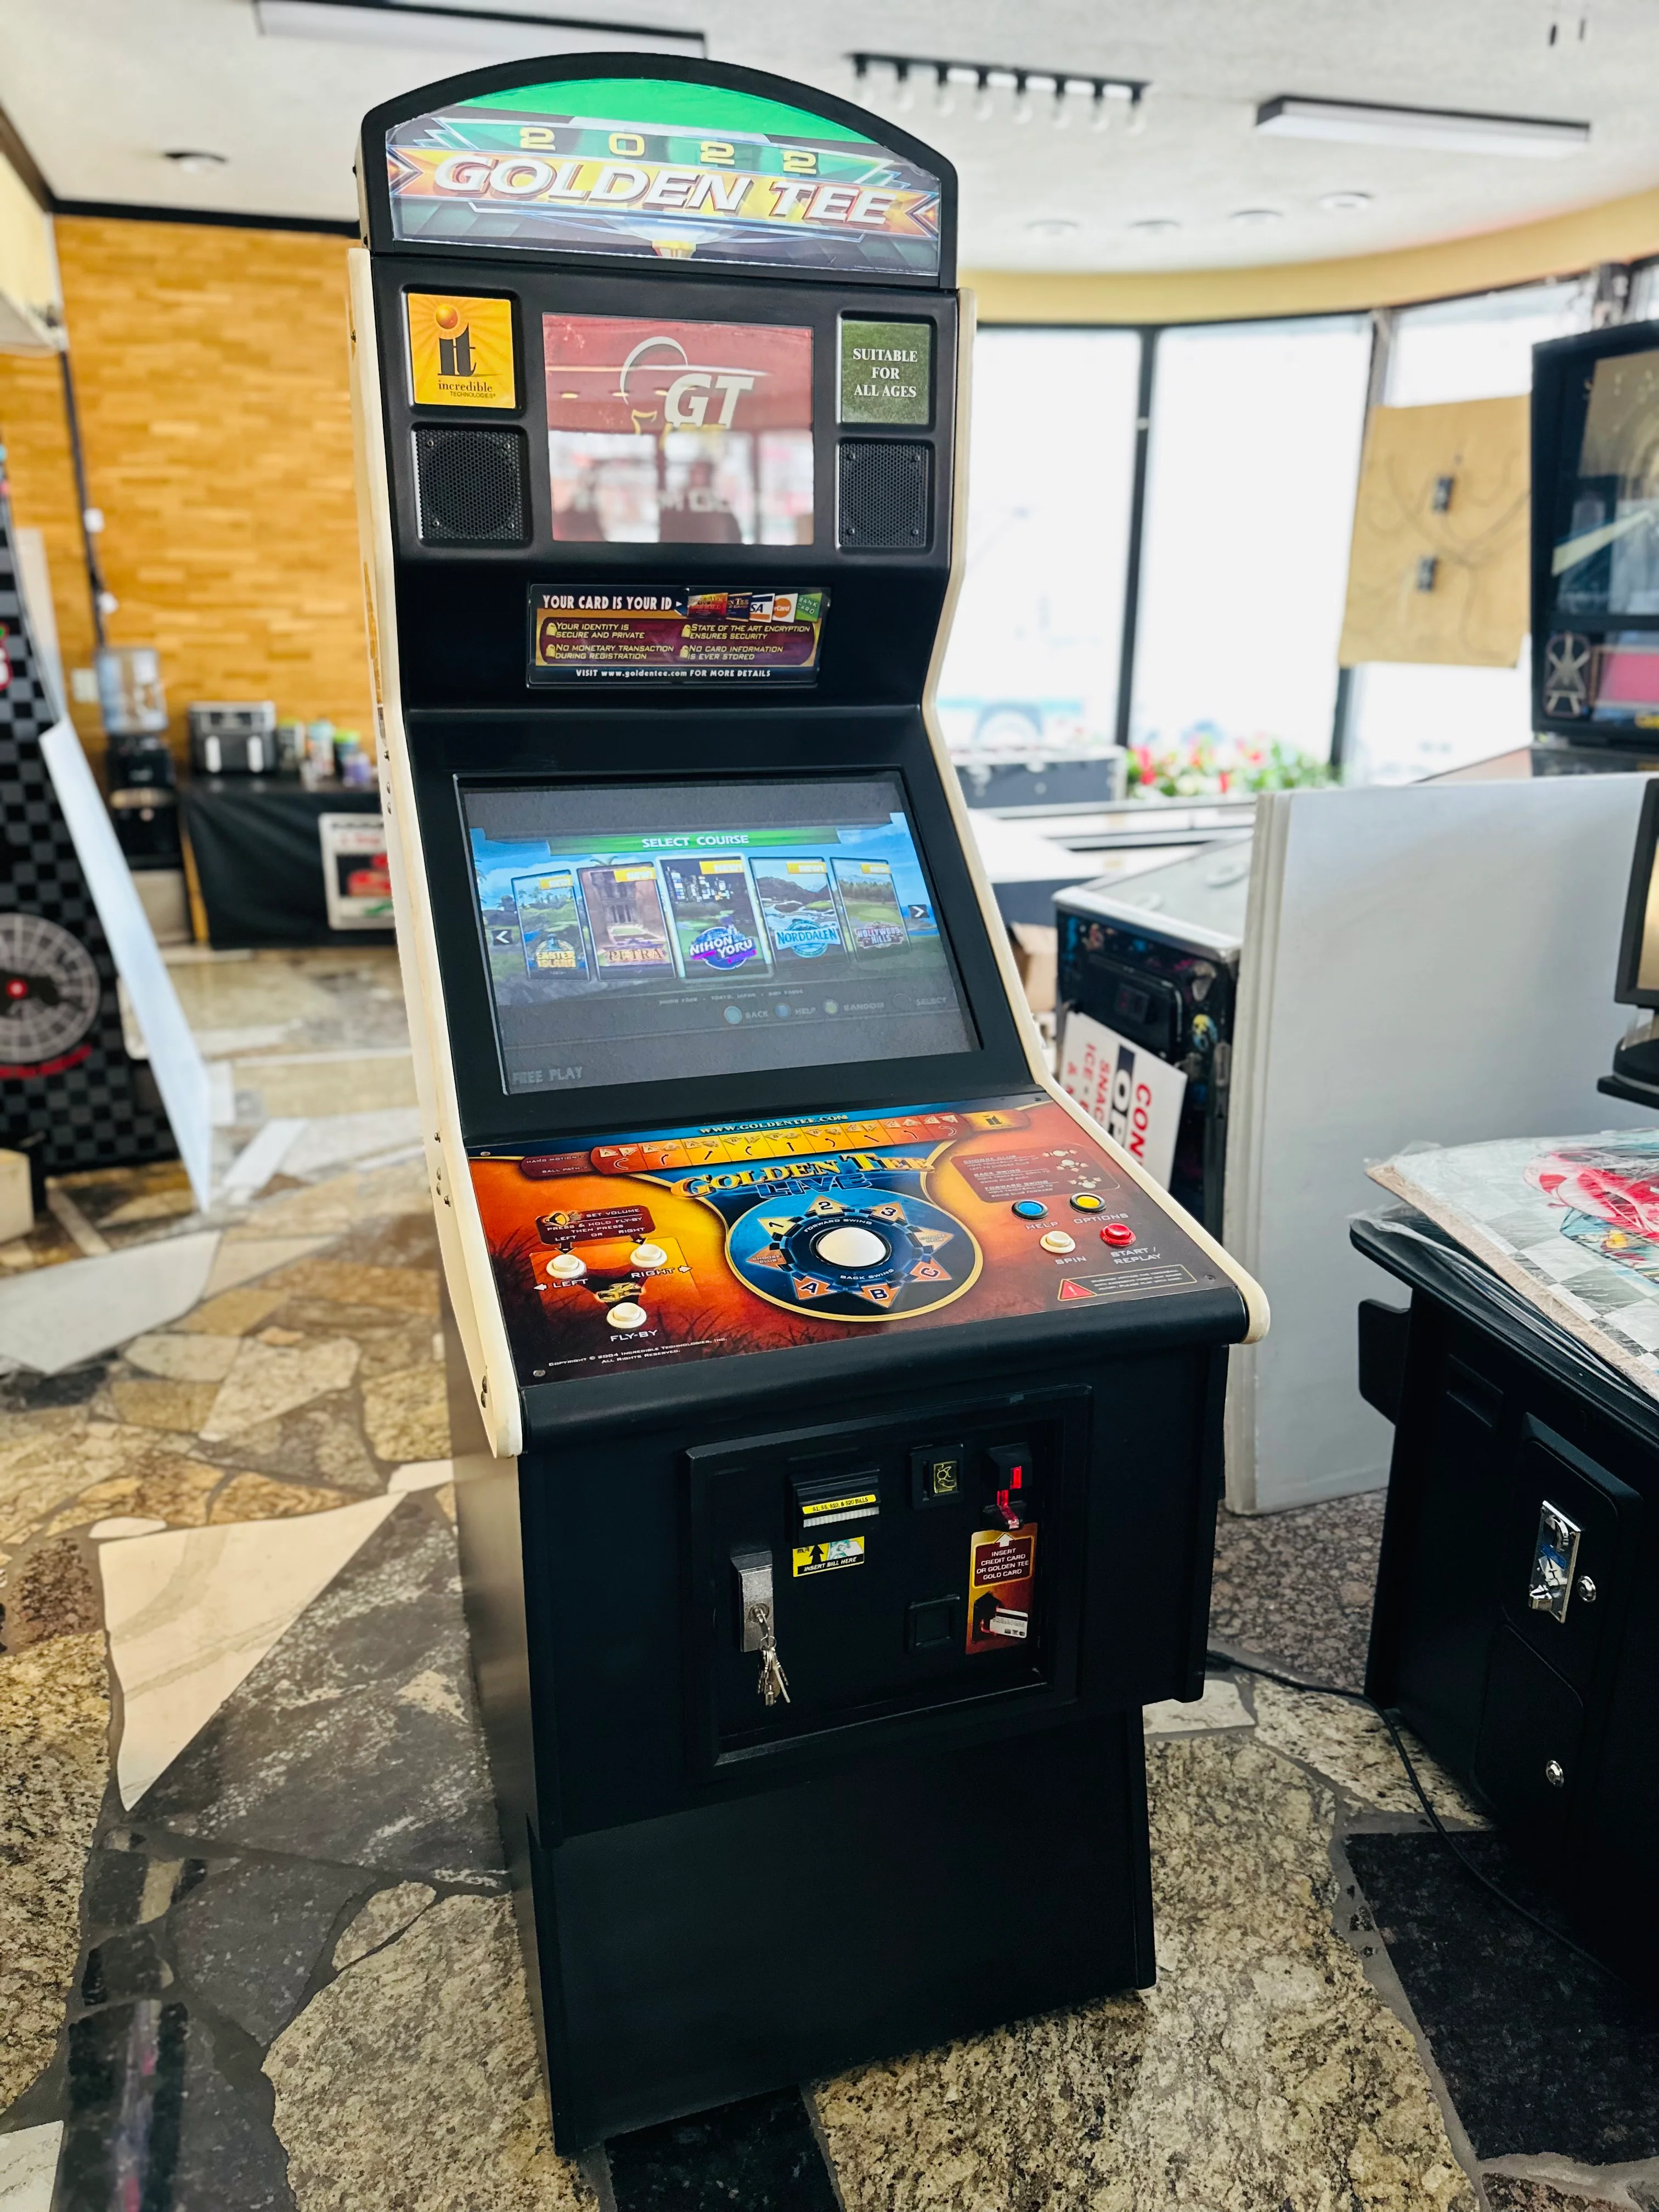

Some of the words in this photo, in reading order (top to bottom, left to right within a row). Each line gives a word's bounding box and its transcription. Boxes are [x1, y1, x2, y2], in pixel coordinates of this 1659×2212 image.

[434, 155, 753, 213] GOLDEN
[768, 181, 898, 225] TEE
[853, 348, 917, 362] SUITABLE
[871, 367, 900, 379] FOR
[438, 380, 492, 392] incredible
[854, 385, 879, 396] ALL
[882, 385, 917, 397] AGES
[664, 373, 754, 428] GT
[543, 595, 574, 609] YOUR
[579, 596, 608, 610] CARD
[613, 596, 622, 610] IS
[627, 596, 657, 610] YOUR
[661, 597, 672, 610] ID
[799, 597, 818, 607] BANK
[750, 603, 764, 613] SA
[797, 603, 815, 614] CARD
[556, 622, 579, 630] YOUR
[601, 669, 687, 678] www.goldentee.com
[642, 837, 690, 848] SELECT
[696, 835, 749, 845] COURSE
[777, 928, 837, 945] NORDDALEN
[857, 927, 900, 938] HOLLYWOOD
[872, 934, 891, 944] HILLS
[690, 935, 732, 956] NIHON
[717, 939, 753, 958] YORU
[609, 949, 663, 960] PETRA
[844, 1002, 884, 1011] RANDOM
[916, 997, 946, 1006] SELECT
[746, 1011, 768, 1019] BACK
[1083, 1043, 1096, 1082] ICE
[512, 1070, 543, 1085] FREE
[549, 1066, 583, 1081] PLAY
[699, 1114, 849, 1134] WWW.GOLDENTEE.COM
[1129, 1083, 1151, 1165] CON
[670, 1159, 844, 1198] GOLDEN
[842, 1153, 935, 1173] TEE
[757, 1173, 872, 1199] LIVE
[818, 1201, 833, 1210] 2
[881, 1207, 896, 1216] 3
[1074, 1213, 1129, 1224] OPTIONS
[804, 1219, 840, 1233] FORWARD
[1026, 1221, 1058, 1231] HELP
[1110, 1248, 1148, 1257] START
[1055, 1256, 1087, 1265] SPIN
[1113, 1254, 1161, 1265] REPLAY
[631, 1267, 675, 1278] RIGHT
[868, 1268, 895, 1279] SWING
[921, 1267, 939, 1277] C
[552, 1278, 588, 1289] LEFT
[800, 1282, 818, 1294] A
[870, 1289, 888, 1300] B
[610, 1329, 657, 1342] FLY-BY
[621, 1347, 659, 1356] INCREDIBLE
[992, 1548, 1016, 1557] INSERT
[981, 1557, 1005, 1566] CREDIT
[1007, 1554, 1025, 1562] CARD
[804, 1563, 826, 1572] INSERT
[988, 1563, 1015, 1572] GOLDEN
